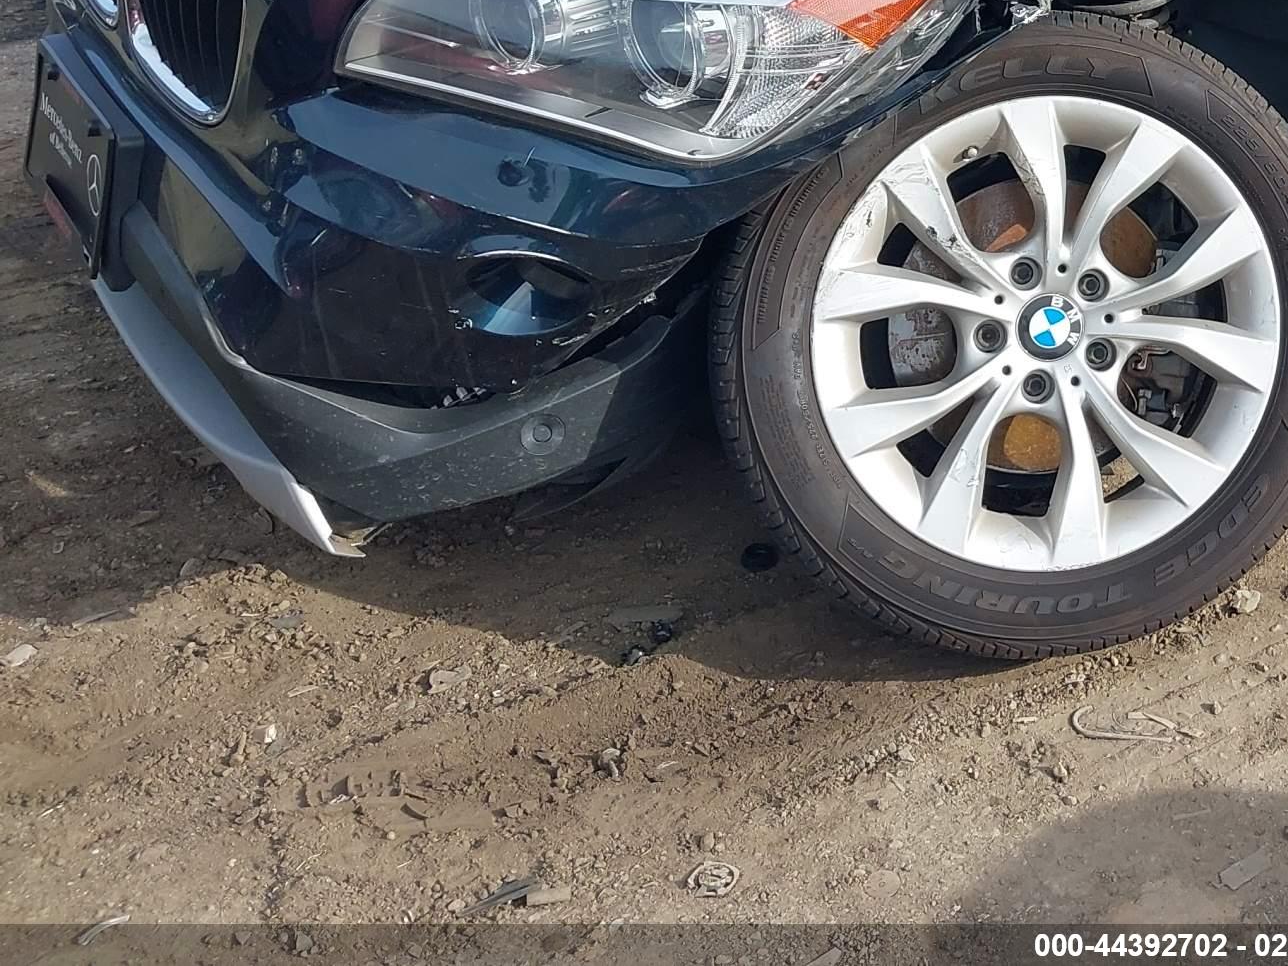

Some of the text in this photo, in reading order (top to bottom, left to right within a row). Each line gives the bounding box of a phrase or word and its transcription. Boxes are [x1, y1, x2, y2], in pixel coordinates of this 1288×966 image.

[919, 55, 1112, 115] KELLY
[1050, 296, 1082, 346] BMW
[1153, 473, 1269, 587] EDGE
[877, 549, 1133, 615] TOURING
